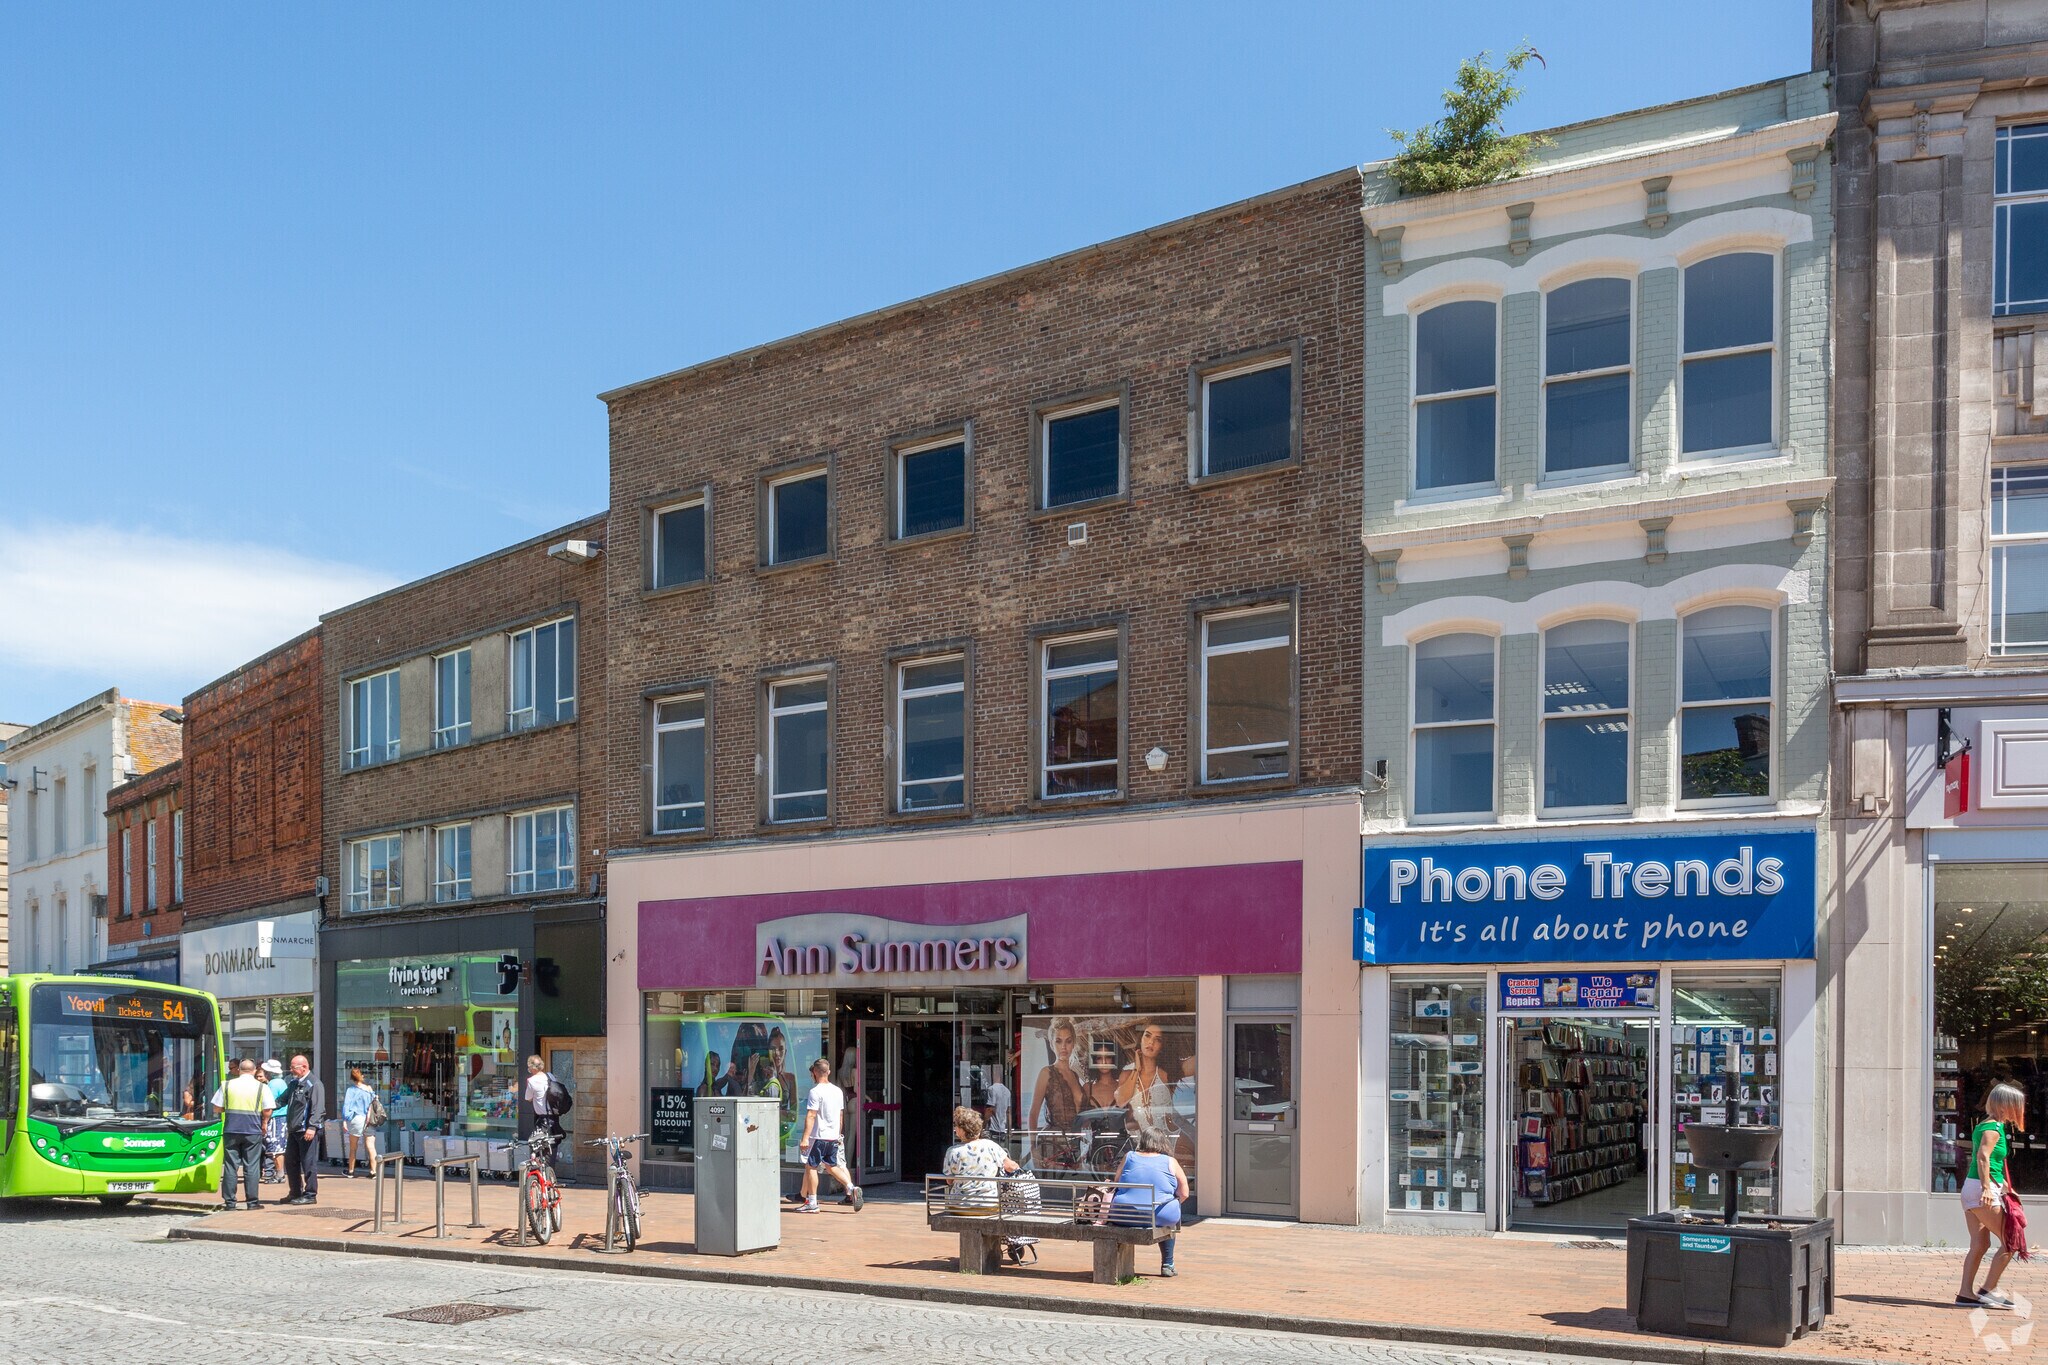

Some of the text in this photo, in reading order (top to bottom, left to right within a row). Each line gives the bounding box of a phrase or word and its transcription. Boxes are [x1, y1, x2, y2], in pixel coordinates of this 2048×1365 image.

[1389, 846, 1785, 903] Phone Trends
[1419, 913, 1749, 948] It's all about phone
[260, 936, 315, 945] BONMARCHE
[759, 932, 1019, 976] Ann Summers
[388, 963, 450, 987] flying tiger
[1507, 978, 1539, 987] Cracked
[1591, 976, 1612, 988] We
[400, 986, 438, 997] copenhagen
[1510, 987, 1537, 996] Screen
[1581, 987, 1623, 998] Repair
[67, 995, 105, 1013] Yeovil
[128, 997, 141, 1008] via
[1505, 996, 1541, 1007] Repairs
[1587, 998, 1616, 1008] Your
[117, 1006, 153, 1018] Ilchester
[162, 1000, 185, 1021] 54
[659, 1095, 687, 1109] 15%
[656, 1110, 689, 1118] STUDENT
[709, 1106, 725, 1114] 409P
[654, 1119, 692, 1127] DISCOUNT
[123, 1137, 166, 1148] Somerset
[112, 1182, 133, 1191] YX58
[1682, 1235, 1726, 1245] Somerset West
